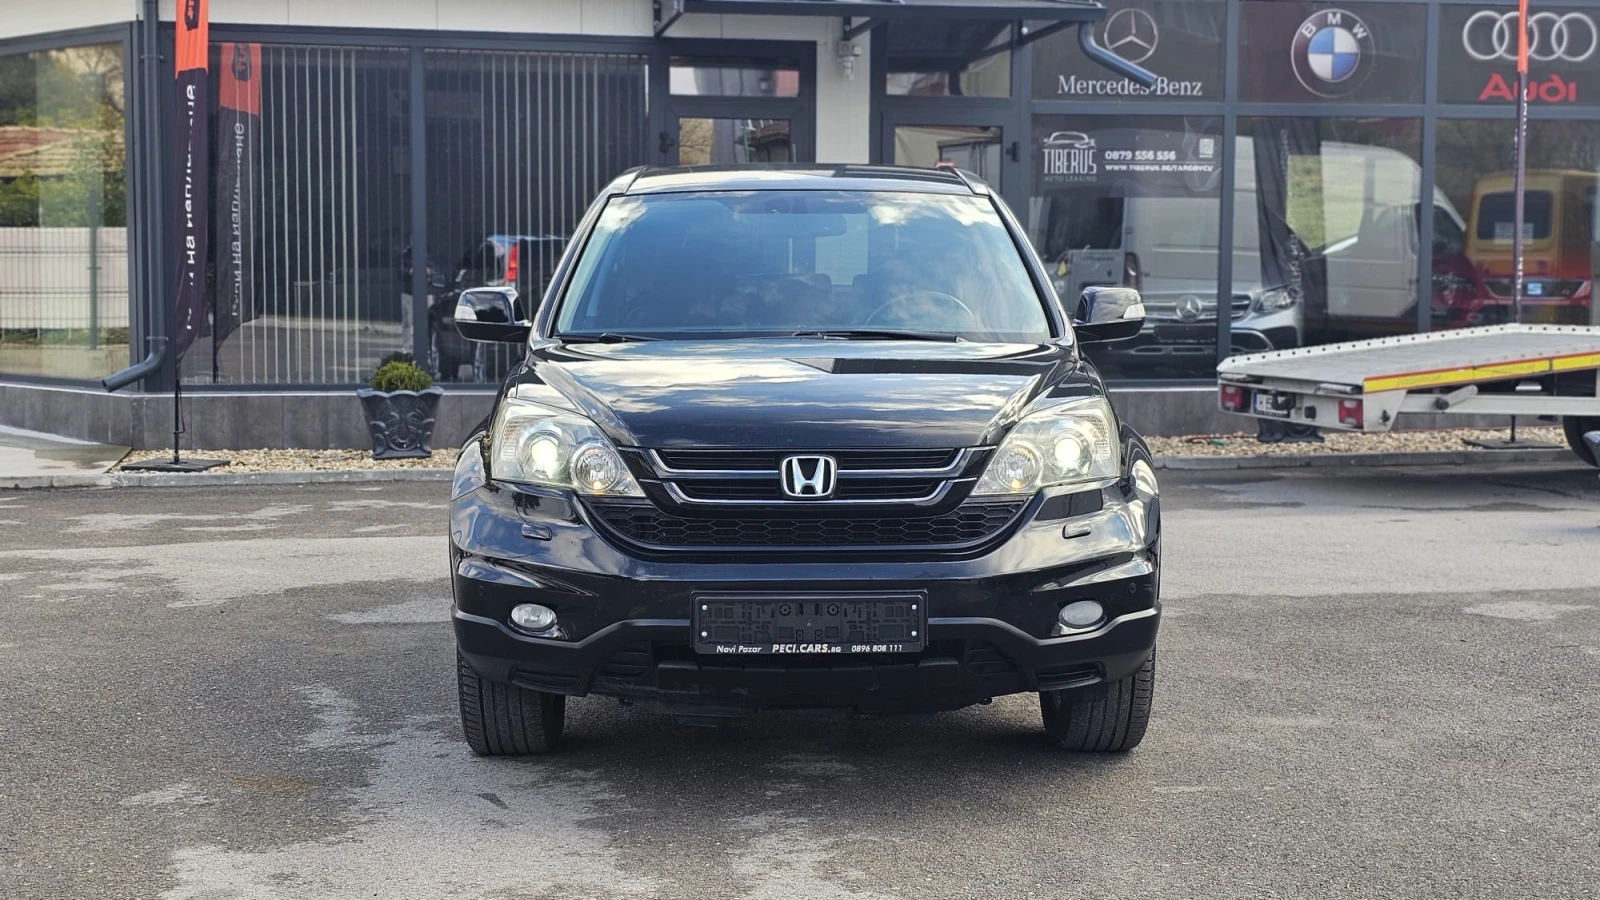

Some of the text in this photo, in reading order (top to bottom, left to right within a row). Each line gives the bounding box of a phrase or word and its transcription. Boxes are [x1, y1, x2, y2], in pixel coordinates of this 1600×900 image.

[1301, 12, 1367, 39] BMW
[1057, 75, 1203, 96] Mercedes-Benz
[1479, 73, 1577, 102] Audi
[1042, 149, 1097, 174] TIBERUS
[1104, 151, 1177, 160] 0879 556 556
[1043, 175, 1064, 183] AUTO
[716, 644, 737, 653] Novi
[738, 645, 762, 653] Pazar
[851, 644, 870, 652] 0896
[872, 644, 887, 652] 808
[888, 644, 902, 652] 111
